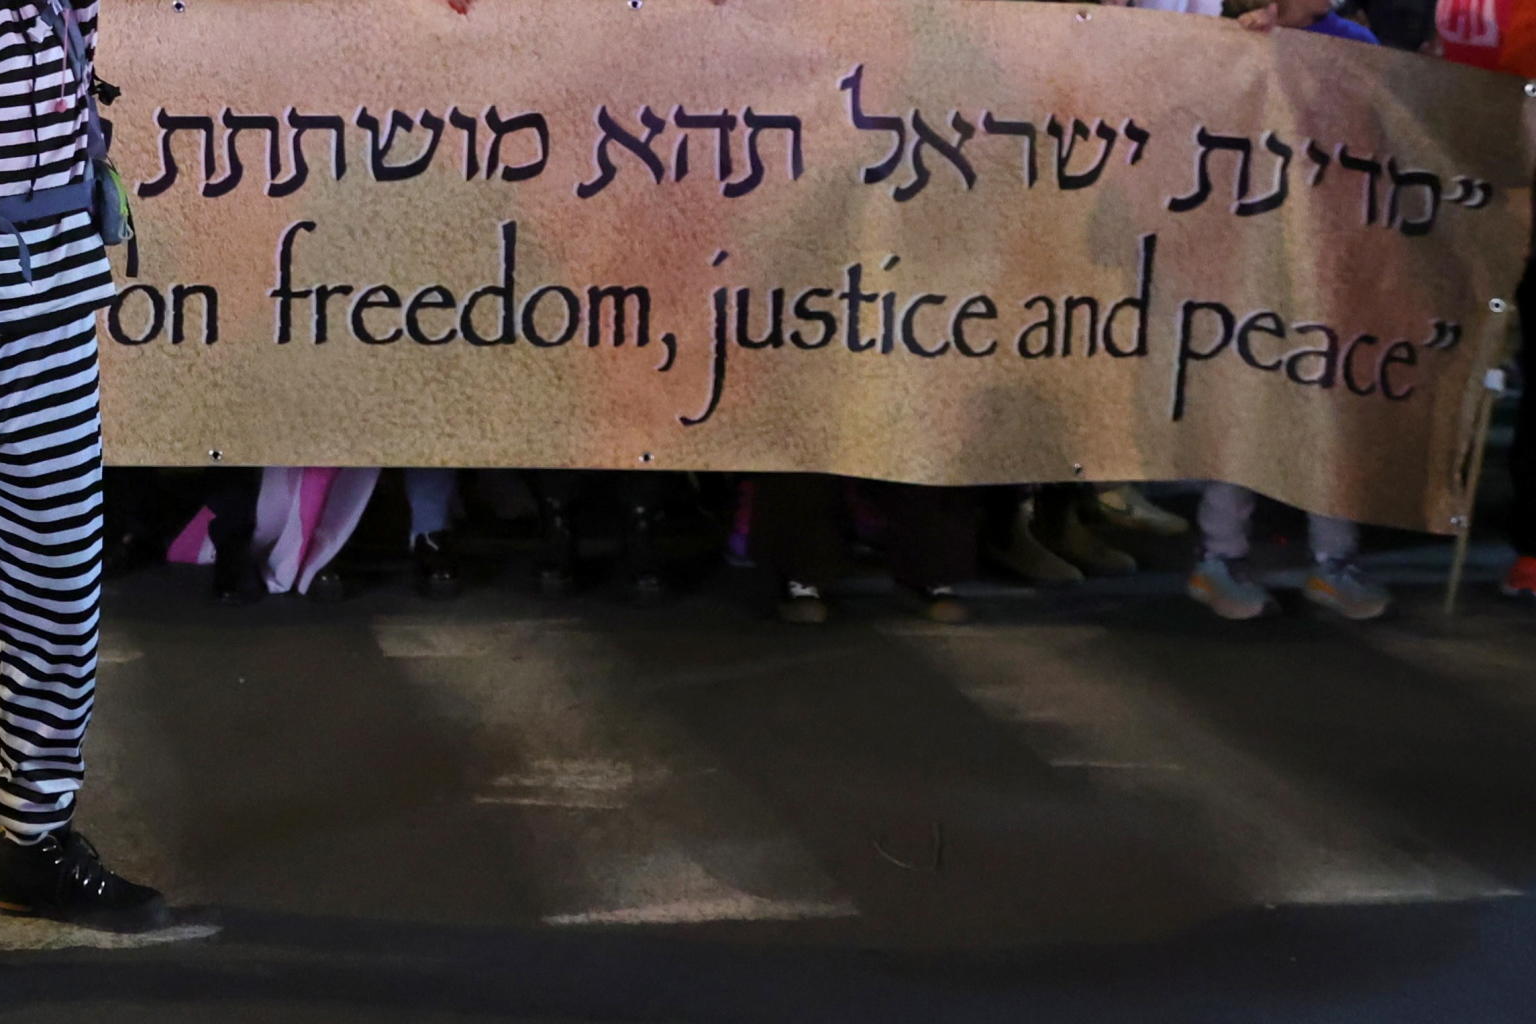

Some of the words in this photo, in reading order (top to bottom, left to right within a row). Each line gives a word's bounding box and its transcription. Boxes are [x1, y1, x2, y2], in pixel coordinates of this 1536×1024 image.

[136, 104, 550, 199] מושתתת
[573, 104, 803, 199] תהא
[839, 63, 1150, 203] ישראל
[106, 282, 219, 346] on
[269, 220, 678, 372] freedom,
[679, 251, 998, 426] justice
[1015, 232, 1157, 360] and
